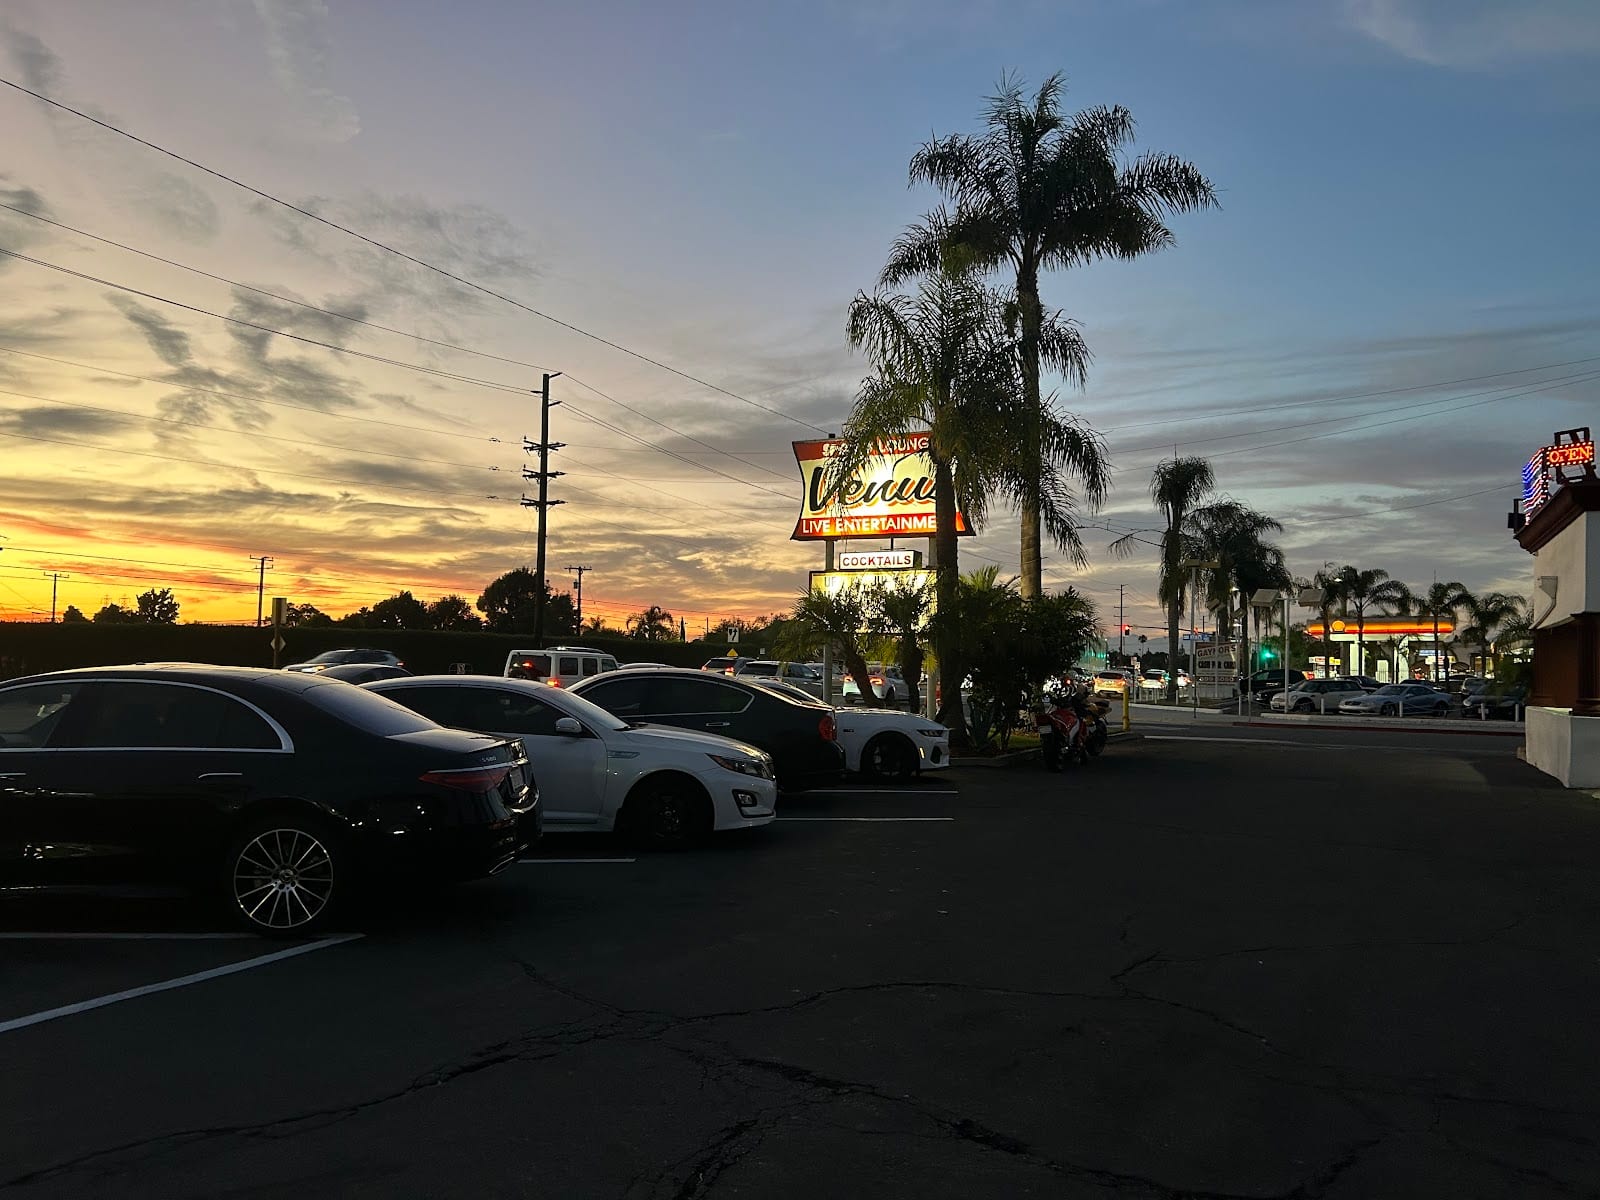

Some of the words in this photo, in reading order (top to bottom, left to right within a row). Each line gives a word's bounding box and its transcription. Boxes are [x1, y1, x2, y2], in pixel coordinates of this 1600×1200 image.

[878, 437, 930, 452] LOUNG
[1549, 446, 1591, 462] OPEN
[809, 466, 937, 511] Venu
[802, 519, 831, 534] LIVE
[836, 516, 936, 532] ENTERTAINME
[842, 555, 911, 566] COCKTAILS
